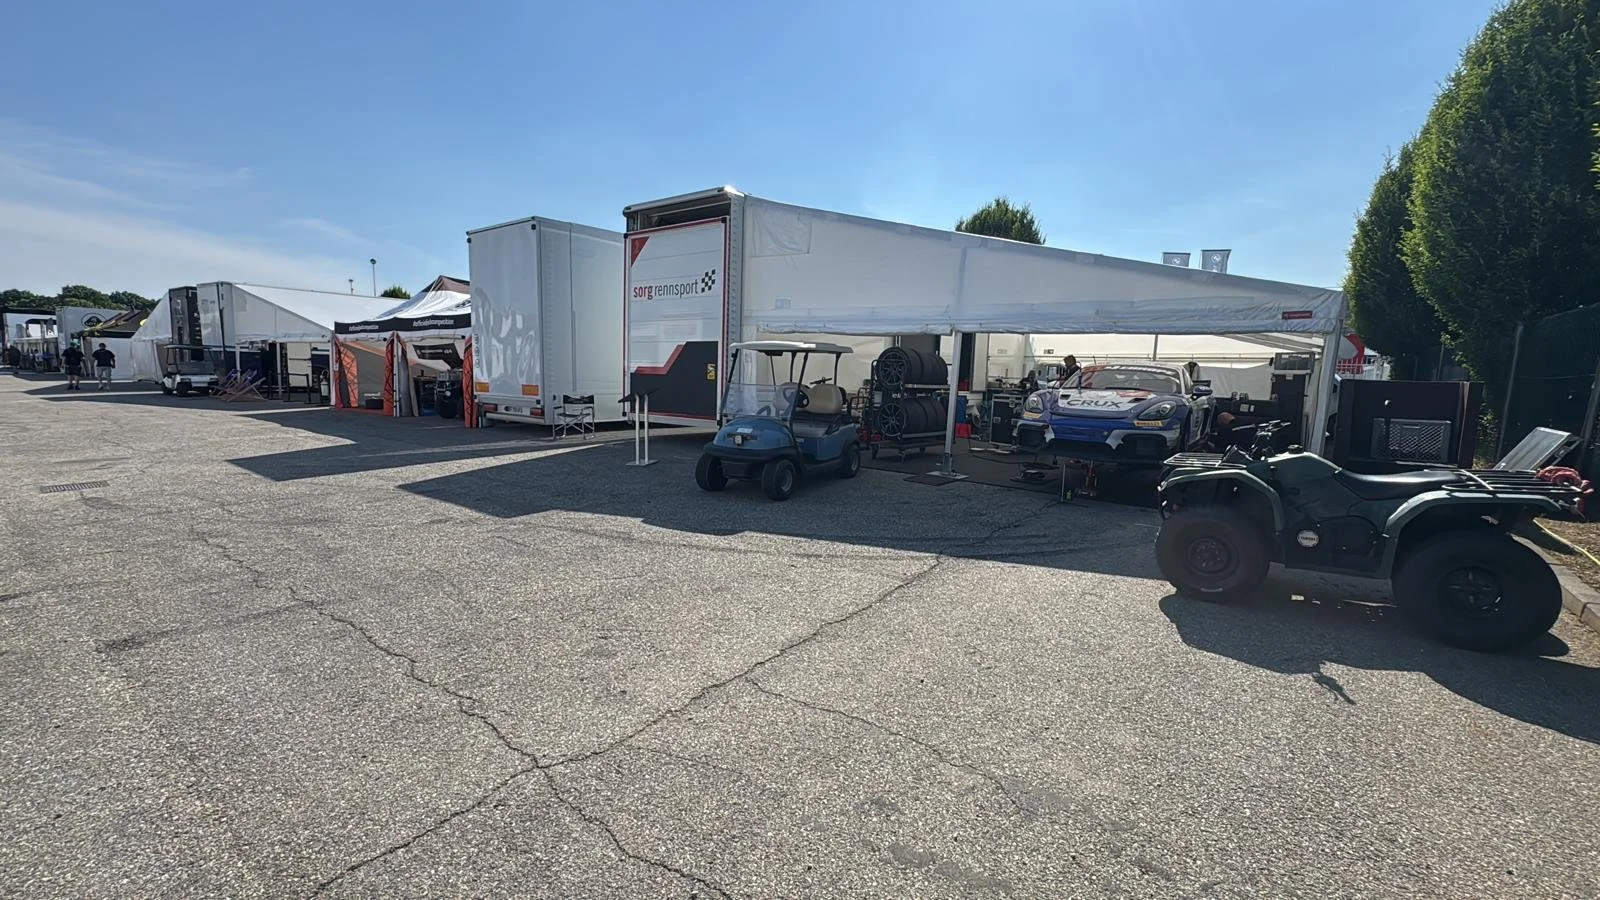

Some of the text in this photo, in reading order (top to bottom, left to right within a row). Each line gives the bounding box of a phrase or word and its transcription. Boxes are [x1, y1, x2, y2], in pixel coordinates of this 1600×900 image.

[633, 279, 698, 300] sorg rennsport
[1066, 399, 1121, 409] CRUX
